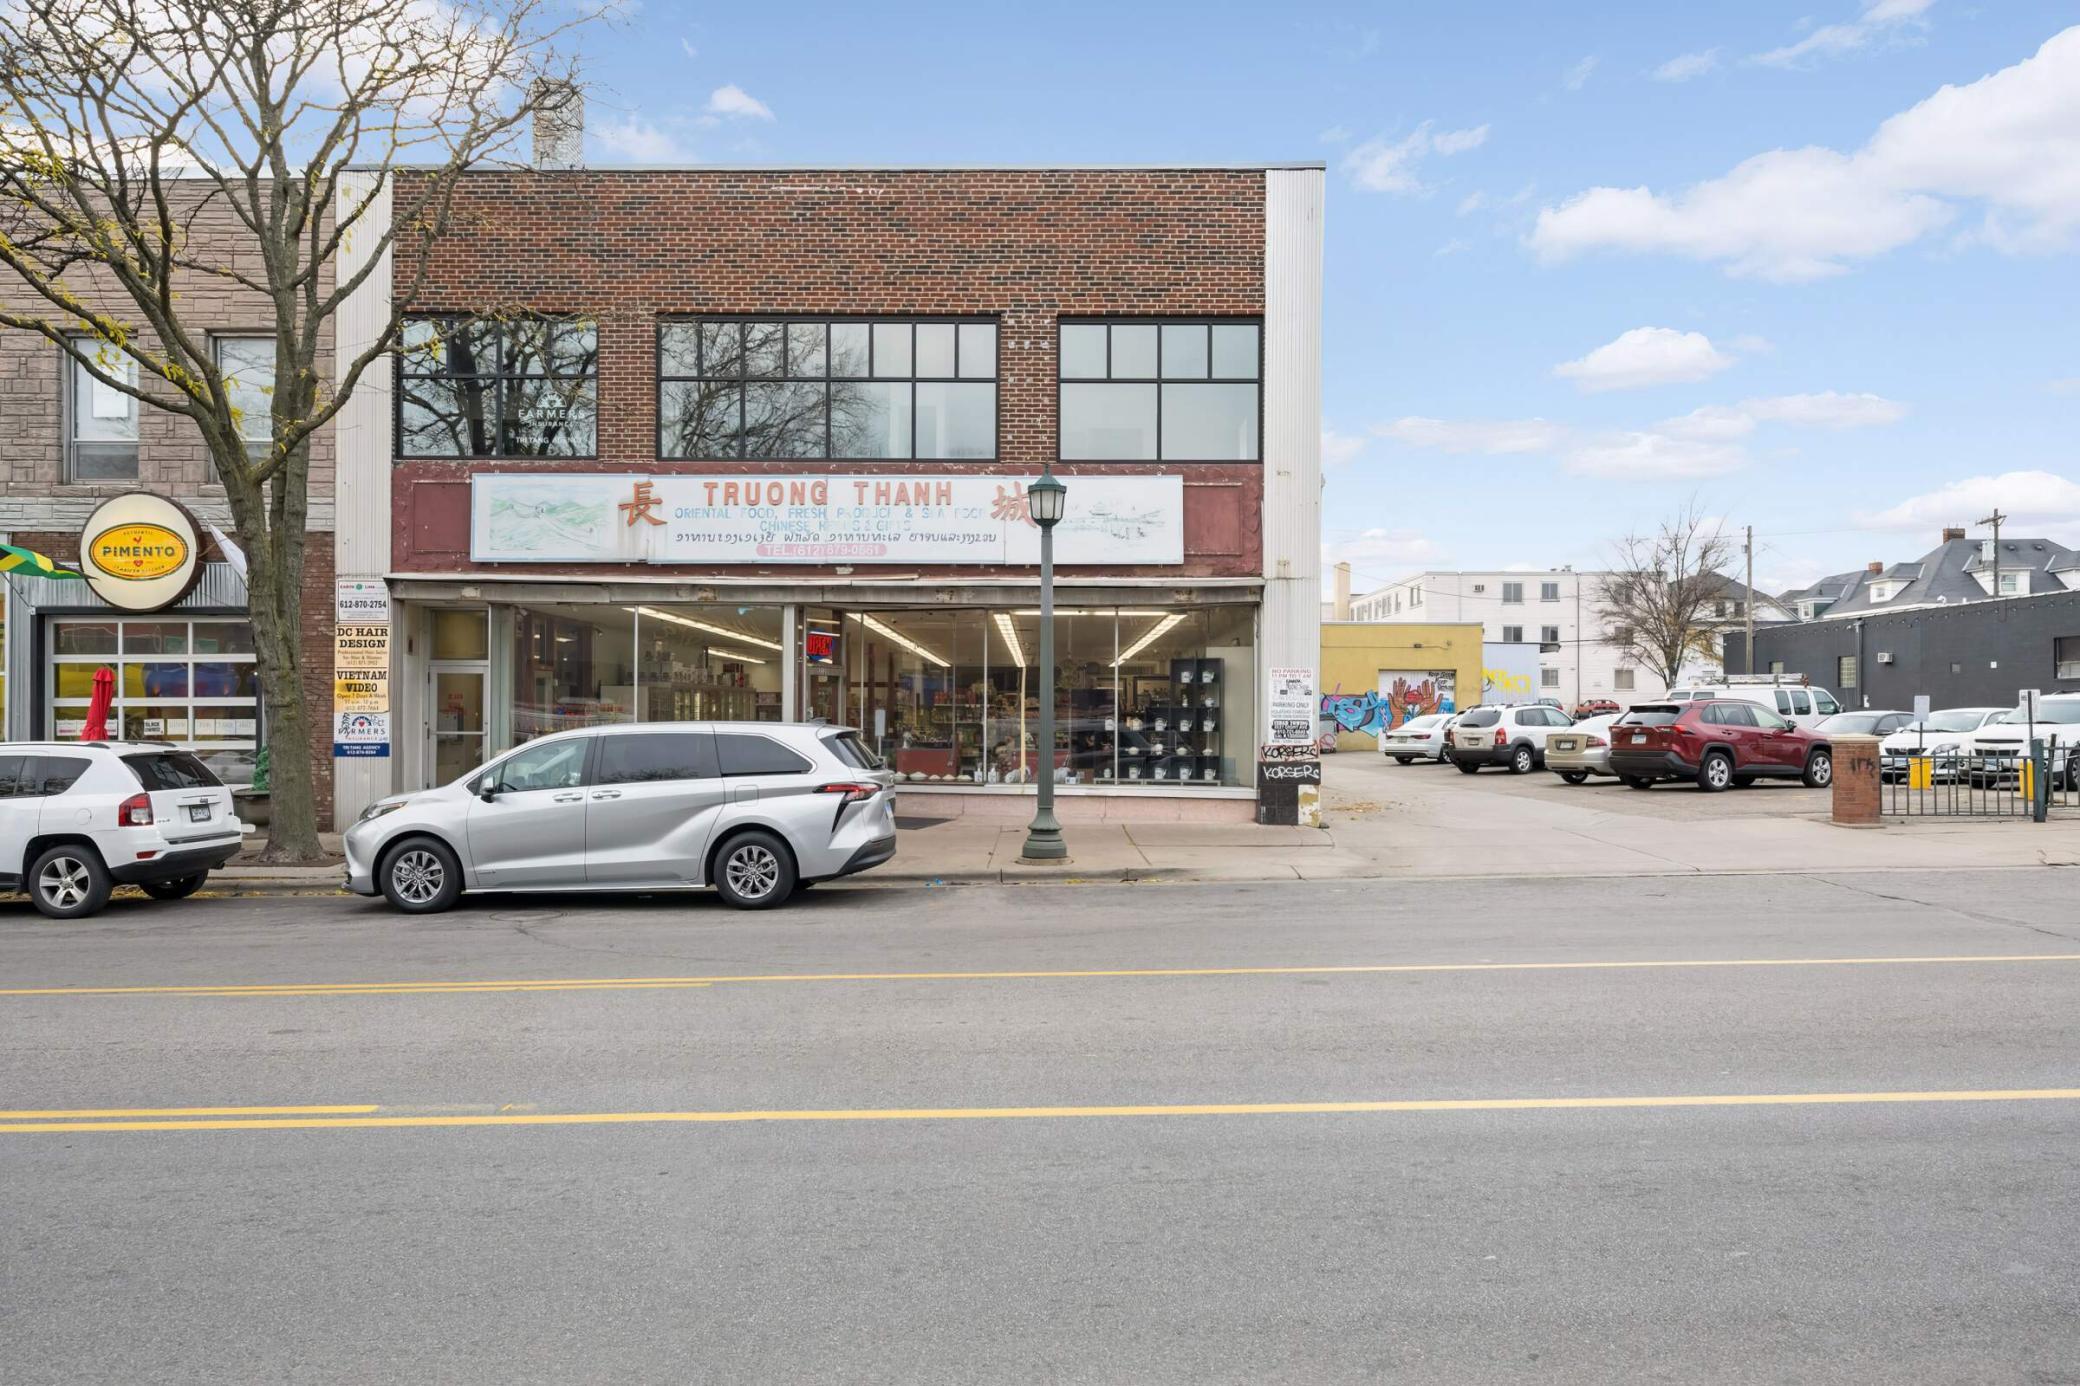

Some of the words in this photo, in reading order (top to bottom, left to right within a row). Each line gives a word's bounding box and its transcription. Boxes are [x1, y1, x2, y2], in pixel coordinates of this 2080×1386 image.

[703, 481, 827, 506] TRUONG
[853, 480, 952, 506] THANH
[618, 480, 667, 527] 長
[674, 507, 730, 519] ORIENTAL
[787, 507, 827, 519] FRESH
[905, 507, 913, 519] &
[760, 520, 809, 532] CHINESE
[102, 546, 175, 557] PIMENTO
[340, 600, 387, 609] 612-870-2754
[337, 628, 353, 637] DC
[356, 628, 388, 637] HAIR
[339, 639, 387, 648] DESIGN
[336, 671, 387, 680] VIETNAM
[345, 683, 378, 693] VIDEO
